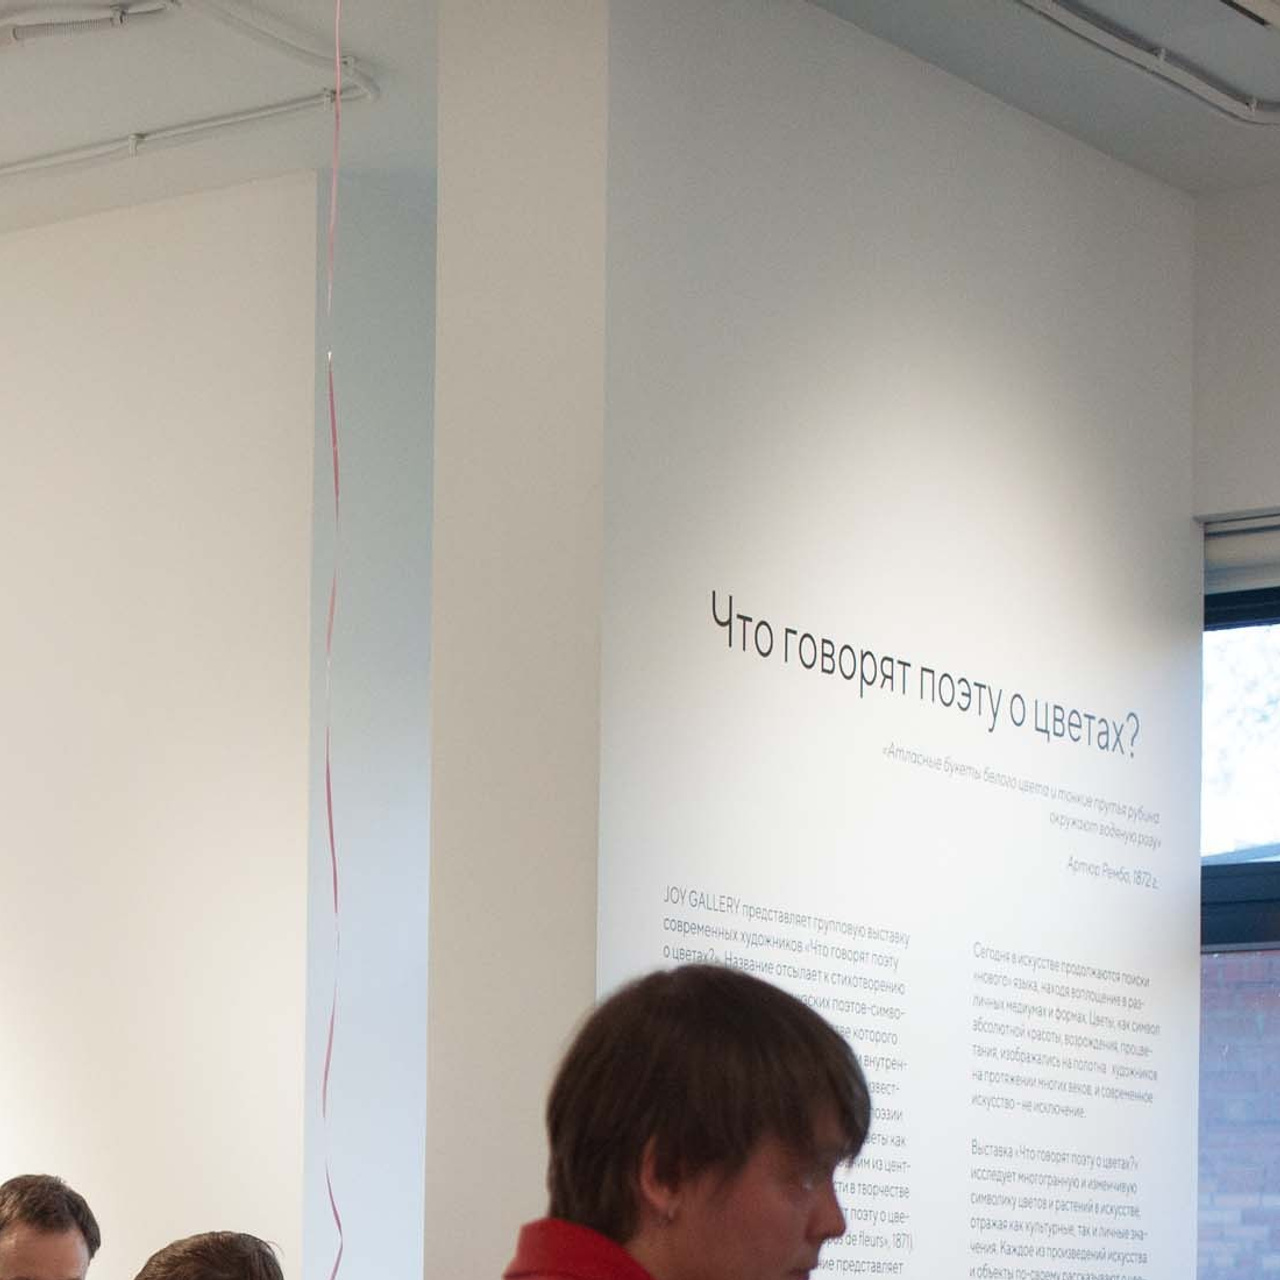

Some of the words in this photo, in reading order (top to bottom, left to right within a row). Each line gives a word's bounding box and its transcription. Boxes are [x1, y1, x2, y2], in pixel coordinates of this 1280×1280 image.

[711, 589, 773, 660] Что
[784, 627, 911, 703] говорят
[920, 665, 1002, 736] поэту
[1009, 691, 1025, 728] о
[1034, 698, 1140, 760] цветах?
[663, 885, 687, 905] JOY
[688, 890, 740, 915] GALLERY
[742, 903, 813, 927] представляет
[814, 916, 866, 939] групповую
[866, 926, 910, 948] выставку
[663, 916, 738, 941] современных
[740, 930, 802, 952] художников
[830, 945, 870, 965] говорят
[872, 952, 899, 972] поэту
[724, 951, 774, 974] Название
[775, 963, 822, 982] отсылает
[831, 972, 906, 995] стихотворению
[852, 1027, 898, 1047] которого
[890, 1133, 906, 1147] как
[971, 1138, 1014, 1158] Выставка
[970, 1167, 1016, 1186] исследует
[857, 1182, 909, 1199] творчестве
[850, 1208, 878, 1225] поэту
[836, 1259, 904, 1275] представляет
